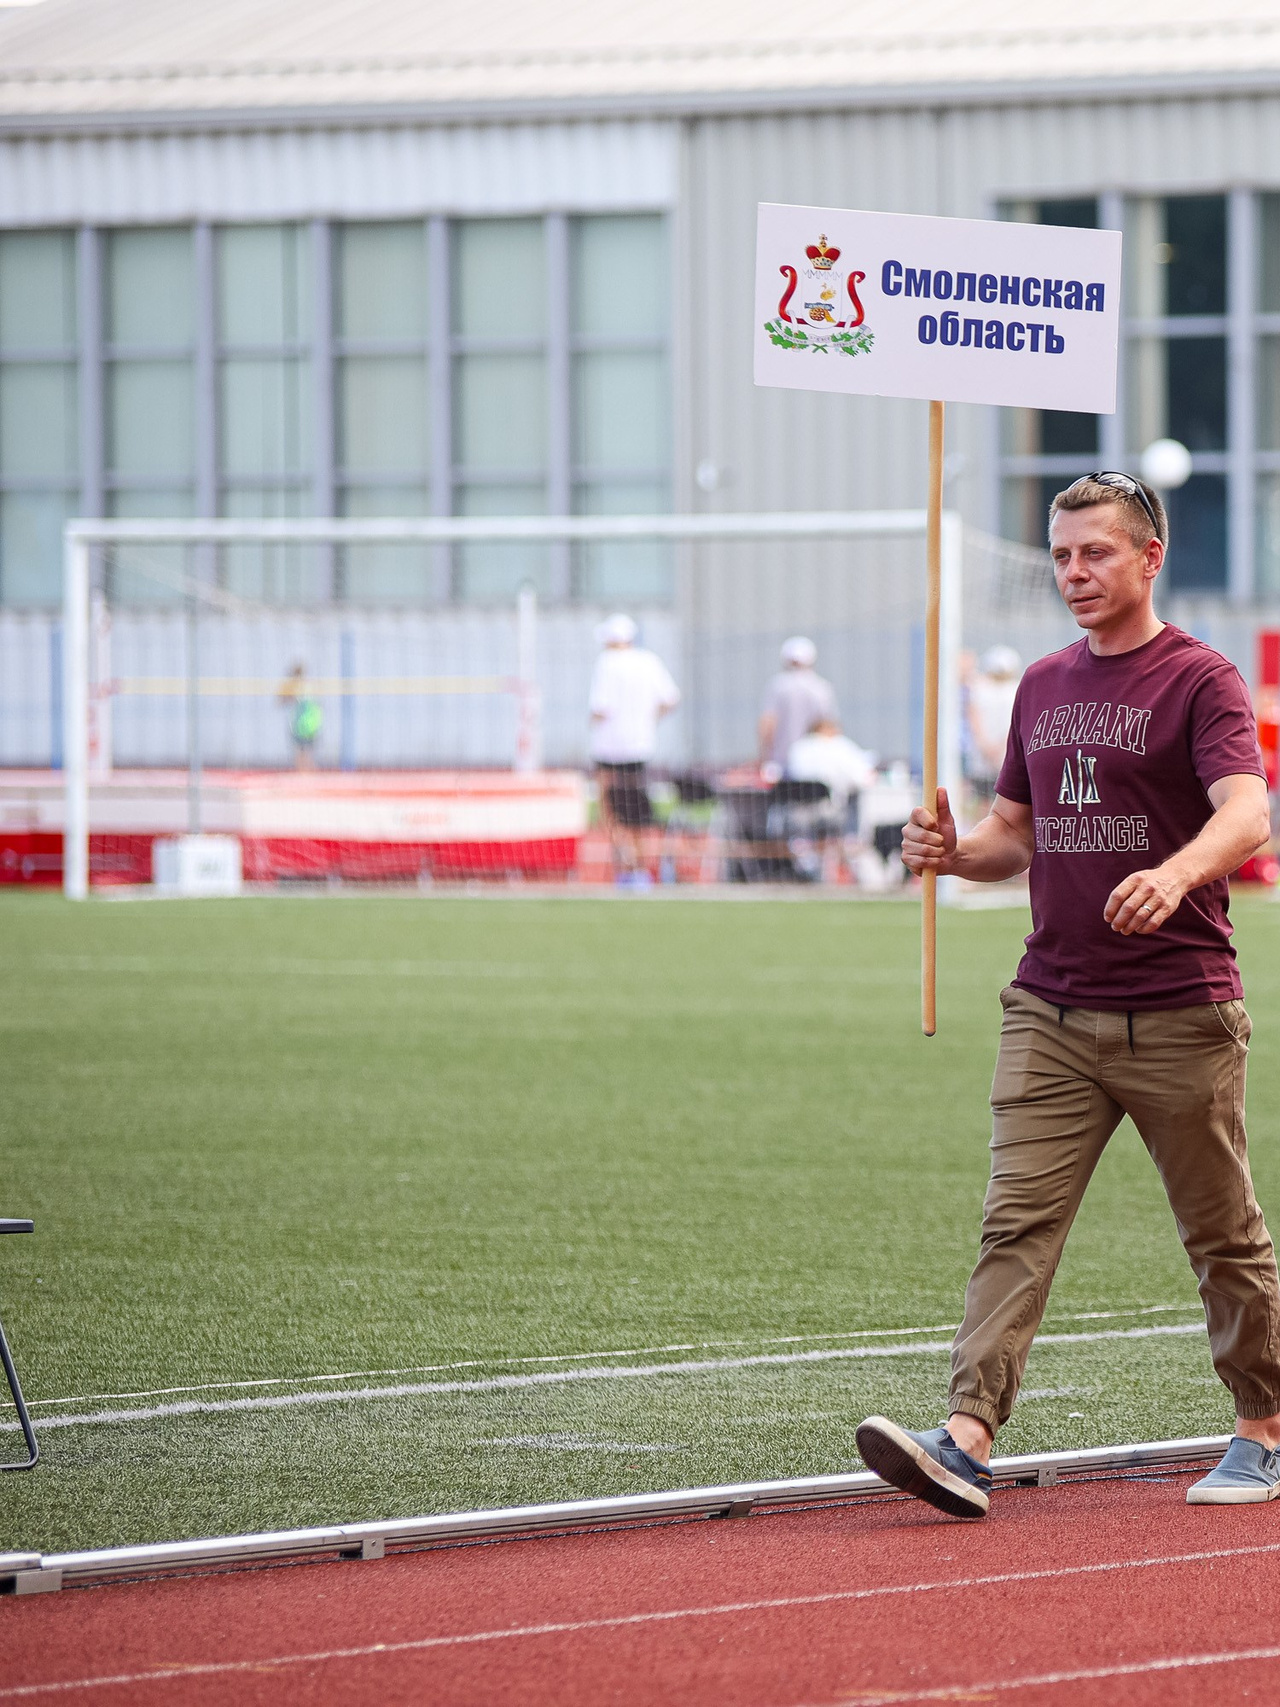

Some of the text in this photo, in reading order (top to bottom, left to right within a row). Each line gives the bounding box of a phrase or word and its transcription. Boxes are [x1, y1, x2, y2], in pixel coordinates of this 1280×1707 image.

[881, 259, 1106, 313] Смоленская
[918, 310, 1066, 355] область
[1027, 702, 1152, 755] ARMANI
